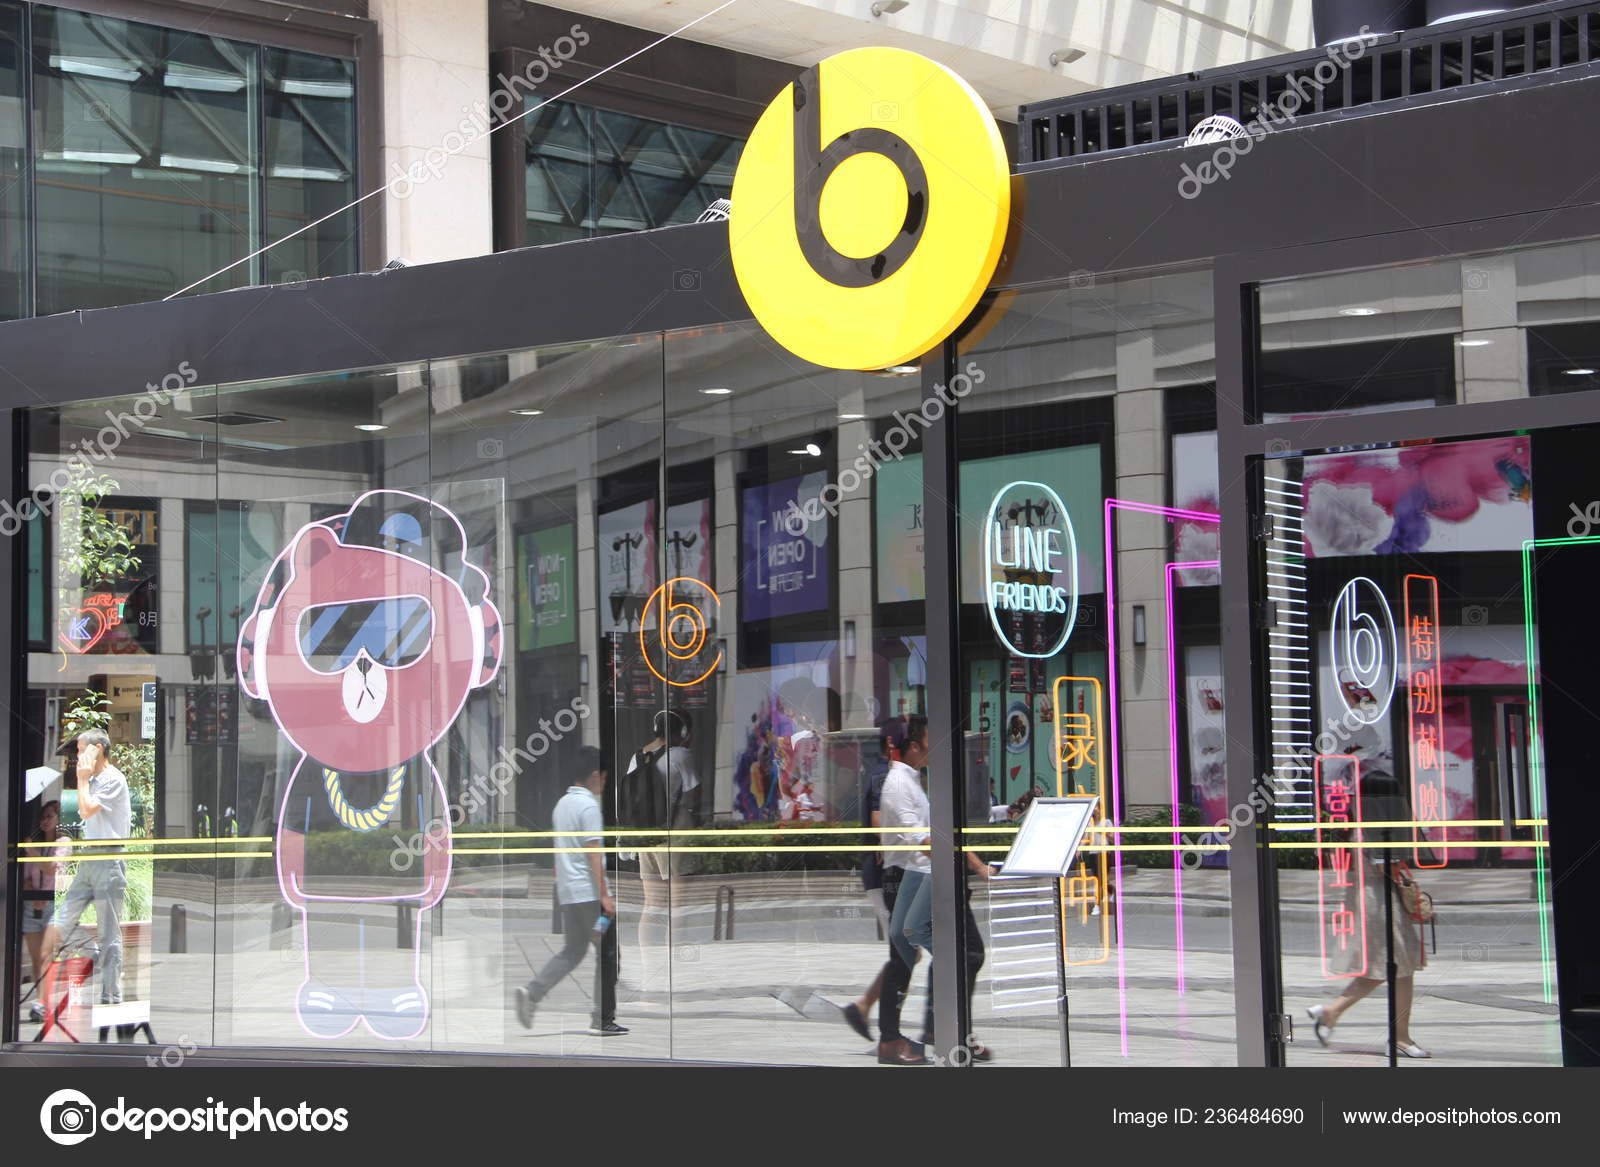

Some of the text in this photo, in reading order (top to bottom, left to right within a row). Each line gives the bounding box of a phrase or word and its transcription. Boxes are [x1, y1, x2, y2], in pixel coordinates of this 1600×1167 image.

[994, 521, 1063, 574] LINE
[992, 581, 1068, 614] FRIENDS
[1061, 713, 1098, 926] 录中
